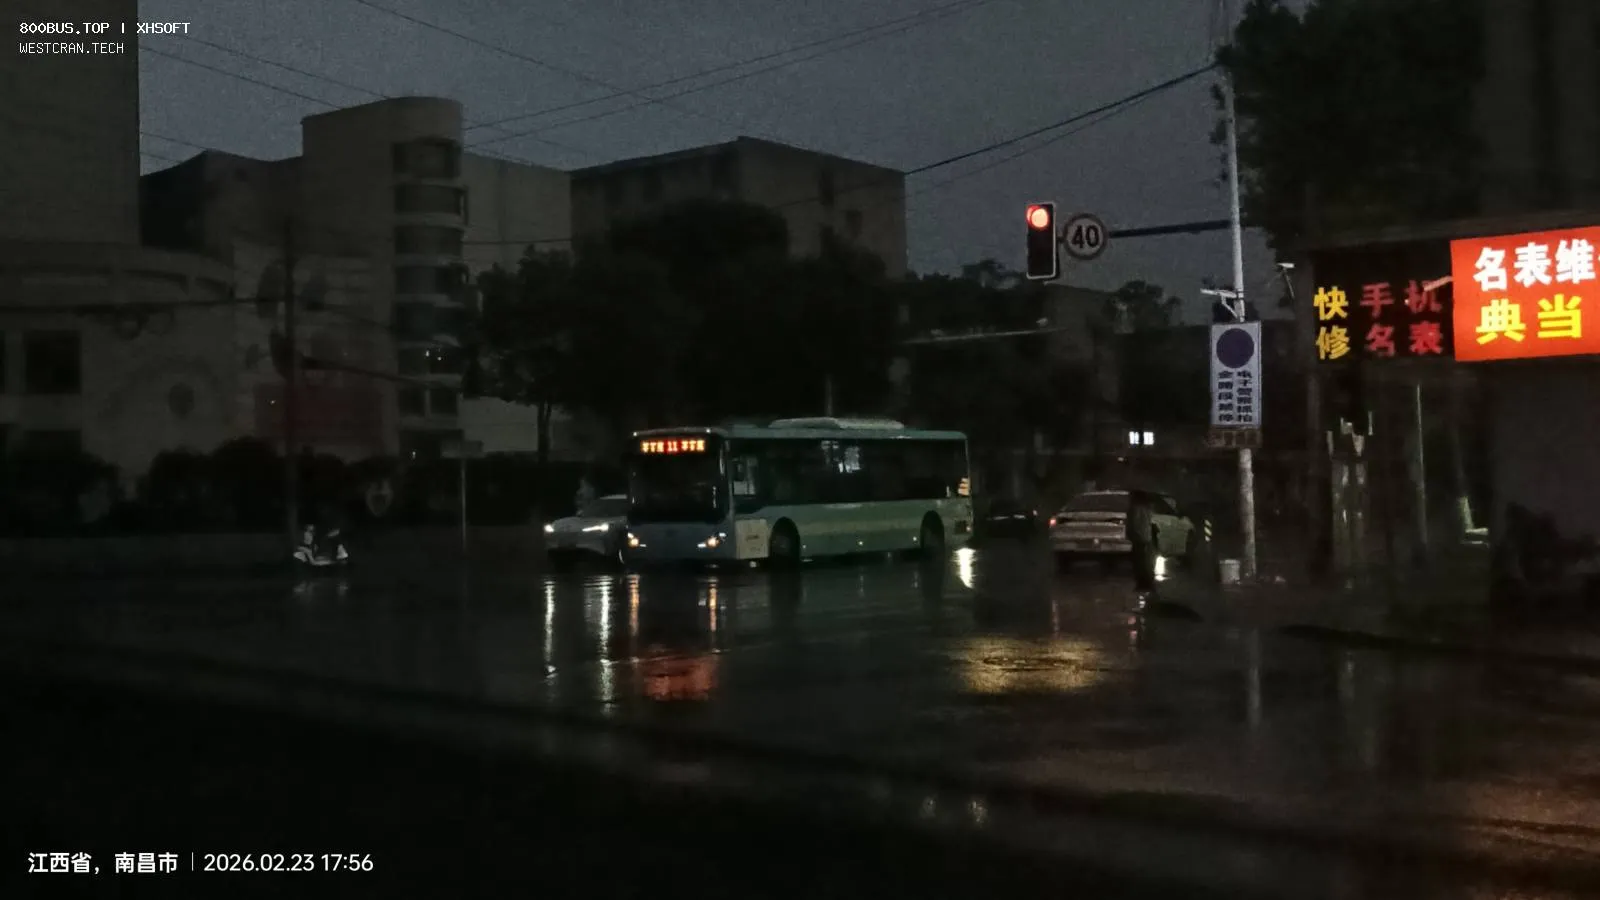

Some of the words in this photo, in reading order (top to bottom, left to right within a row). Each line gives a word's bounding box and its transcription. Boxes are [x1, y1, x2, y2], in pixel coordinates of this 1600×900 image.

[1071, 224, 1100, 249] 40
[1473, 238, 1600, 291] 名表维
[1360, 279, 1443, 318] 手机
[1475, 293, 1583, 345] 典当
[1313, 285, 1351, 360] 快修
[1366, 320, 1444, 357] 名表
